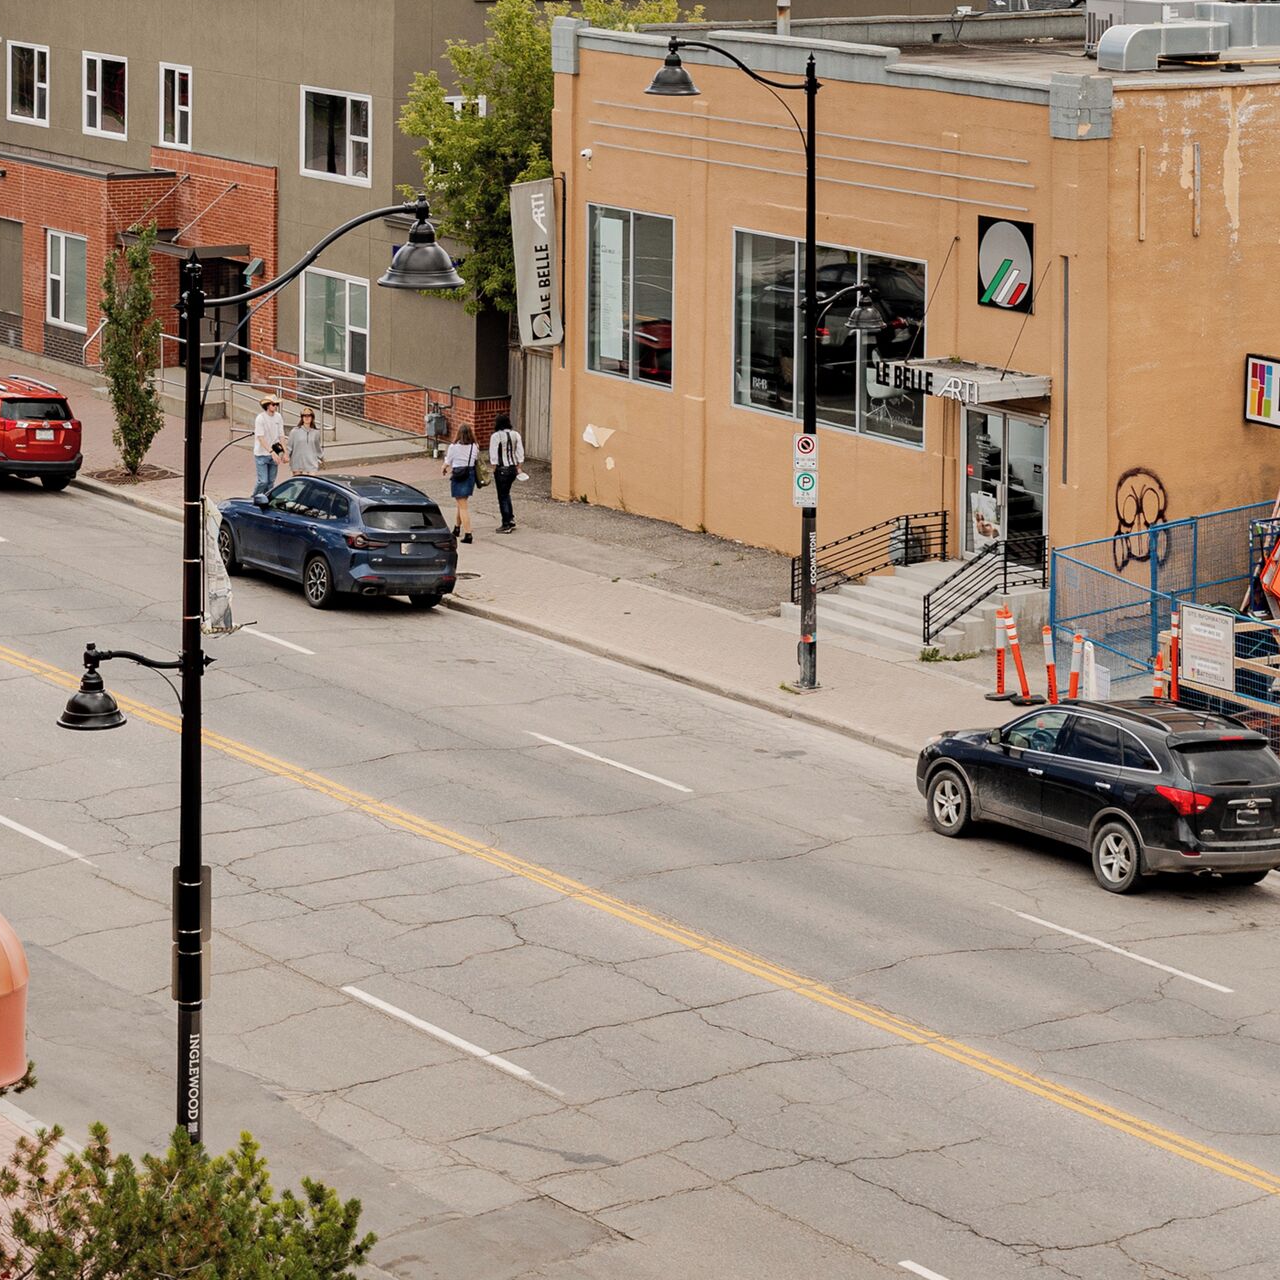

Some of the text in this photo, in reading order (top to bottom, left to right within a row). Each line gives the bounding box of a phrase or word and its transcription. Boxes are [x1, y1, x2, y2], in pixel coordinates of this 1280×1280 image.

[530, 192, 552, 312] LE BELLE ARTI
[876, 361, 979, 405] LE BELLE ARTI
[187, 1033, 201, 1120] INGLEWOOD
